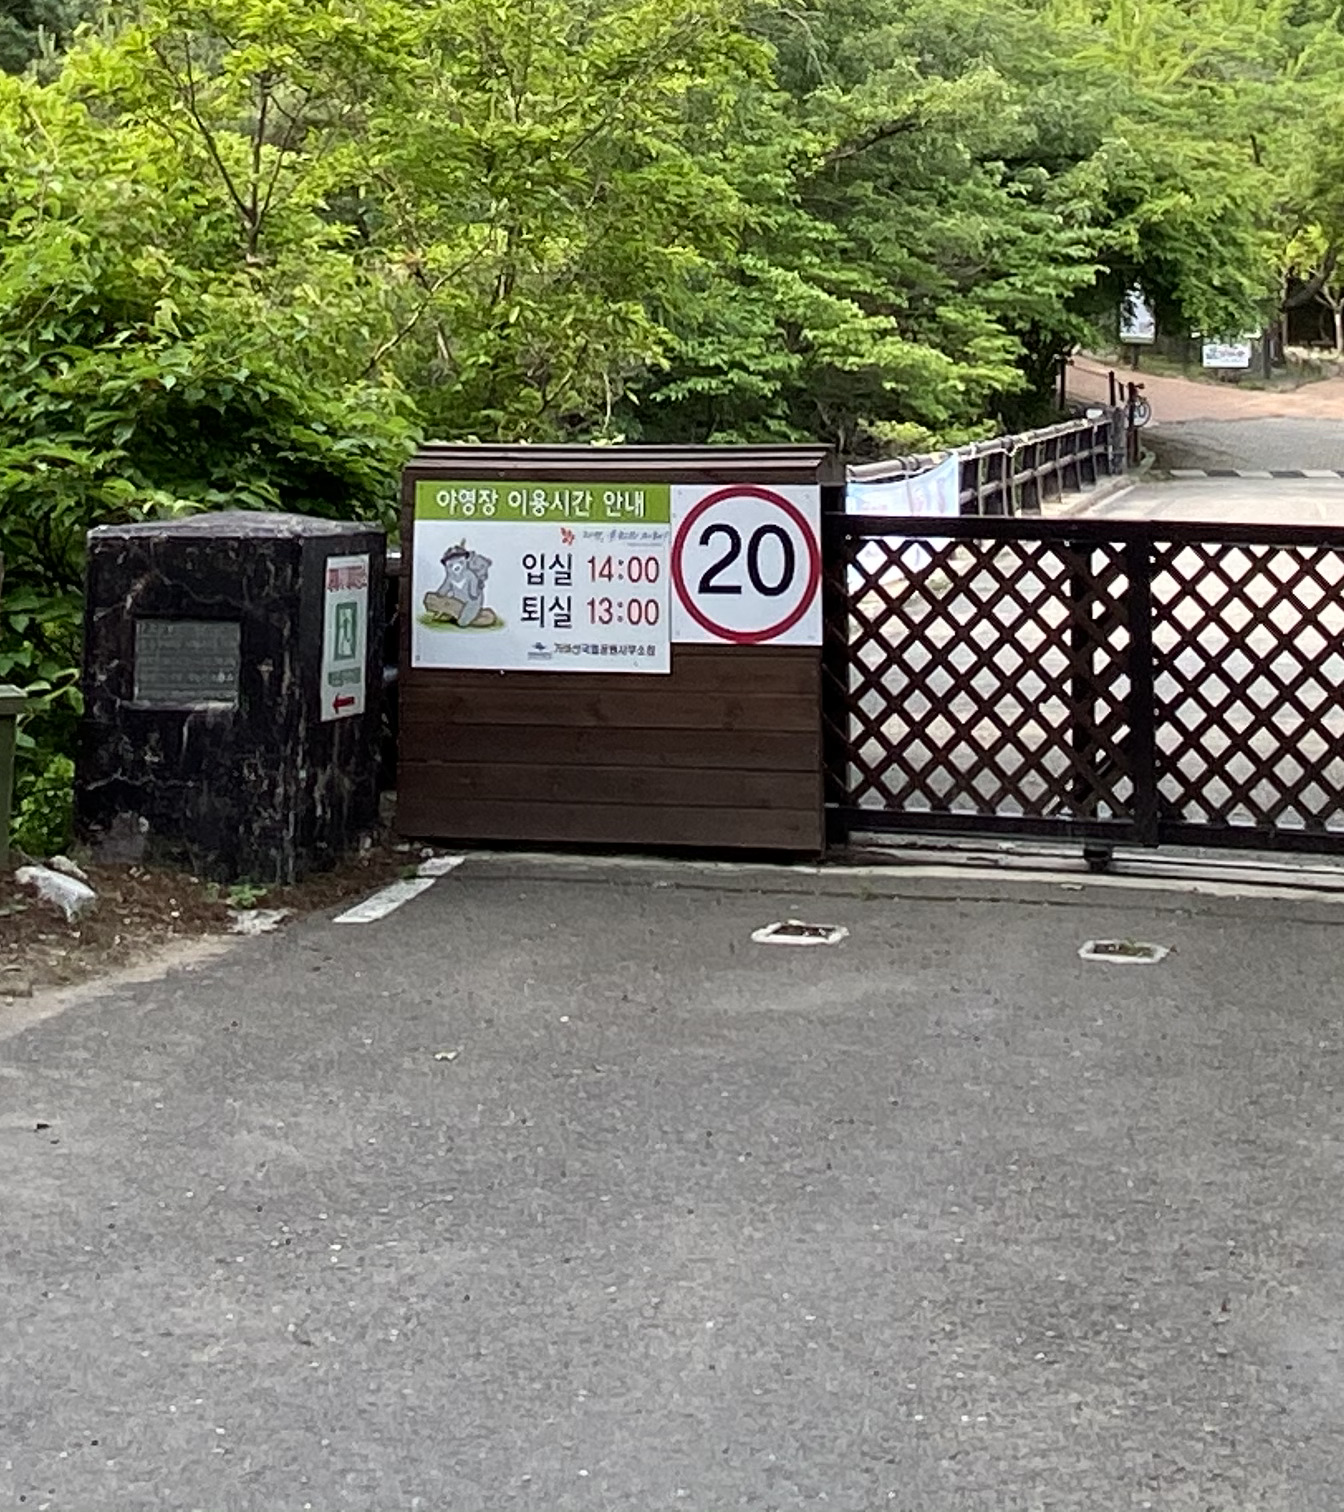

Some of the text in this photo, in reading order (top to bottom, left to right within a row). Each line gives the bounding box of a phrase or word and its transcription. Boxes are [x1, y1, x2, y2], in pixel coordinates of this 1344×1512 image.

[436, 488, 647, 518] 야영장 이용시간 안내
[521, 552, 660, 587] 입실 14:00
[697, 523, 797, 597] 20
[520, 595, 660, 629] 퇴실 13:00
